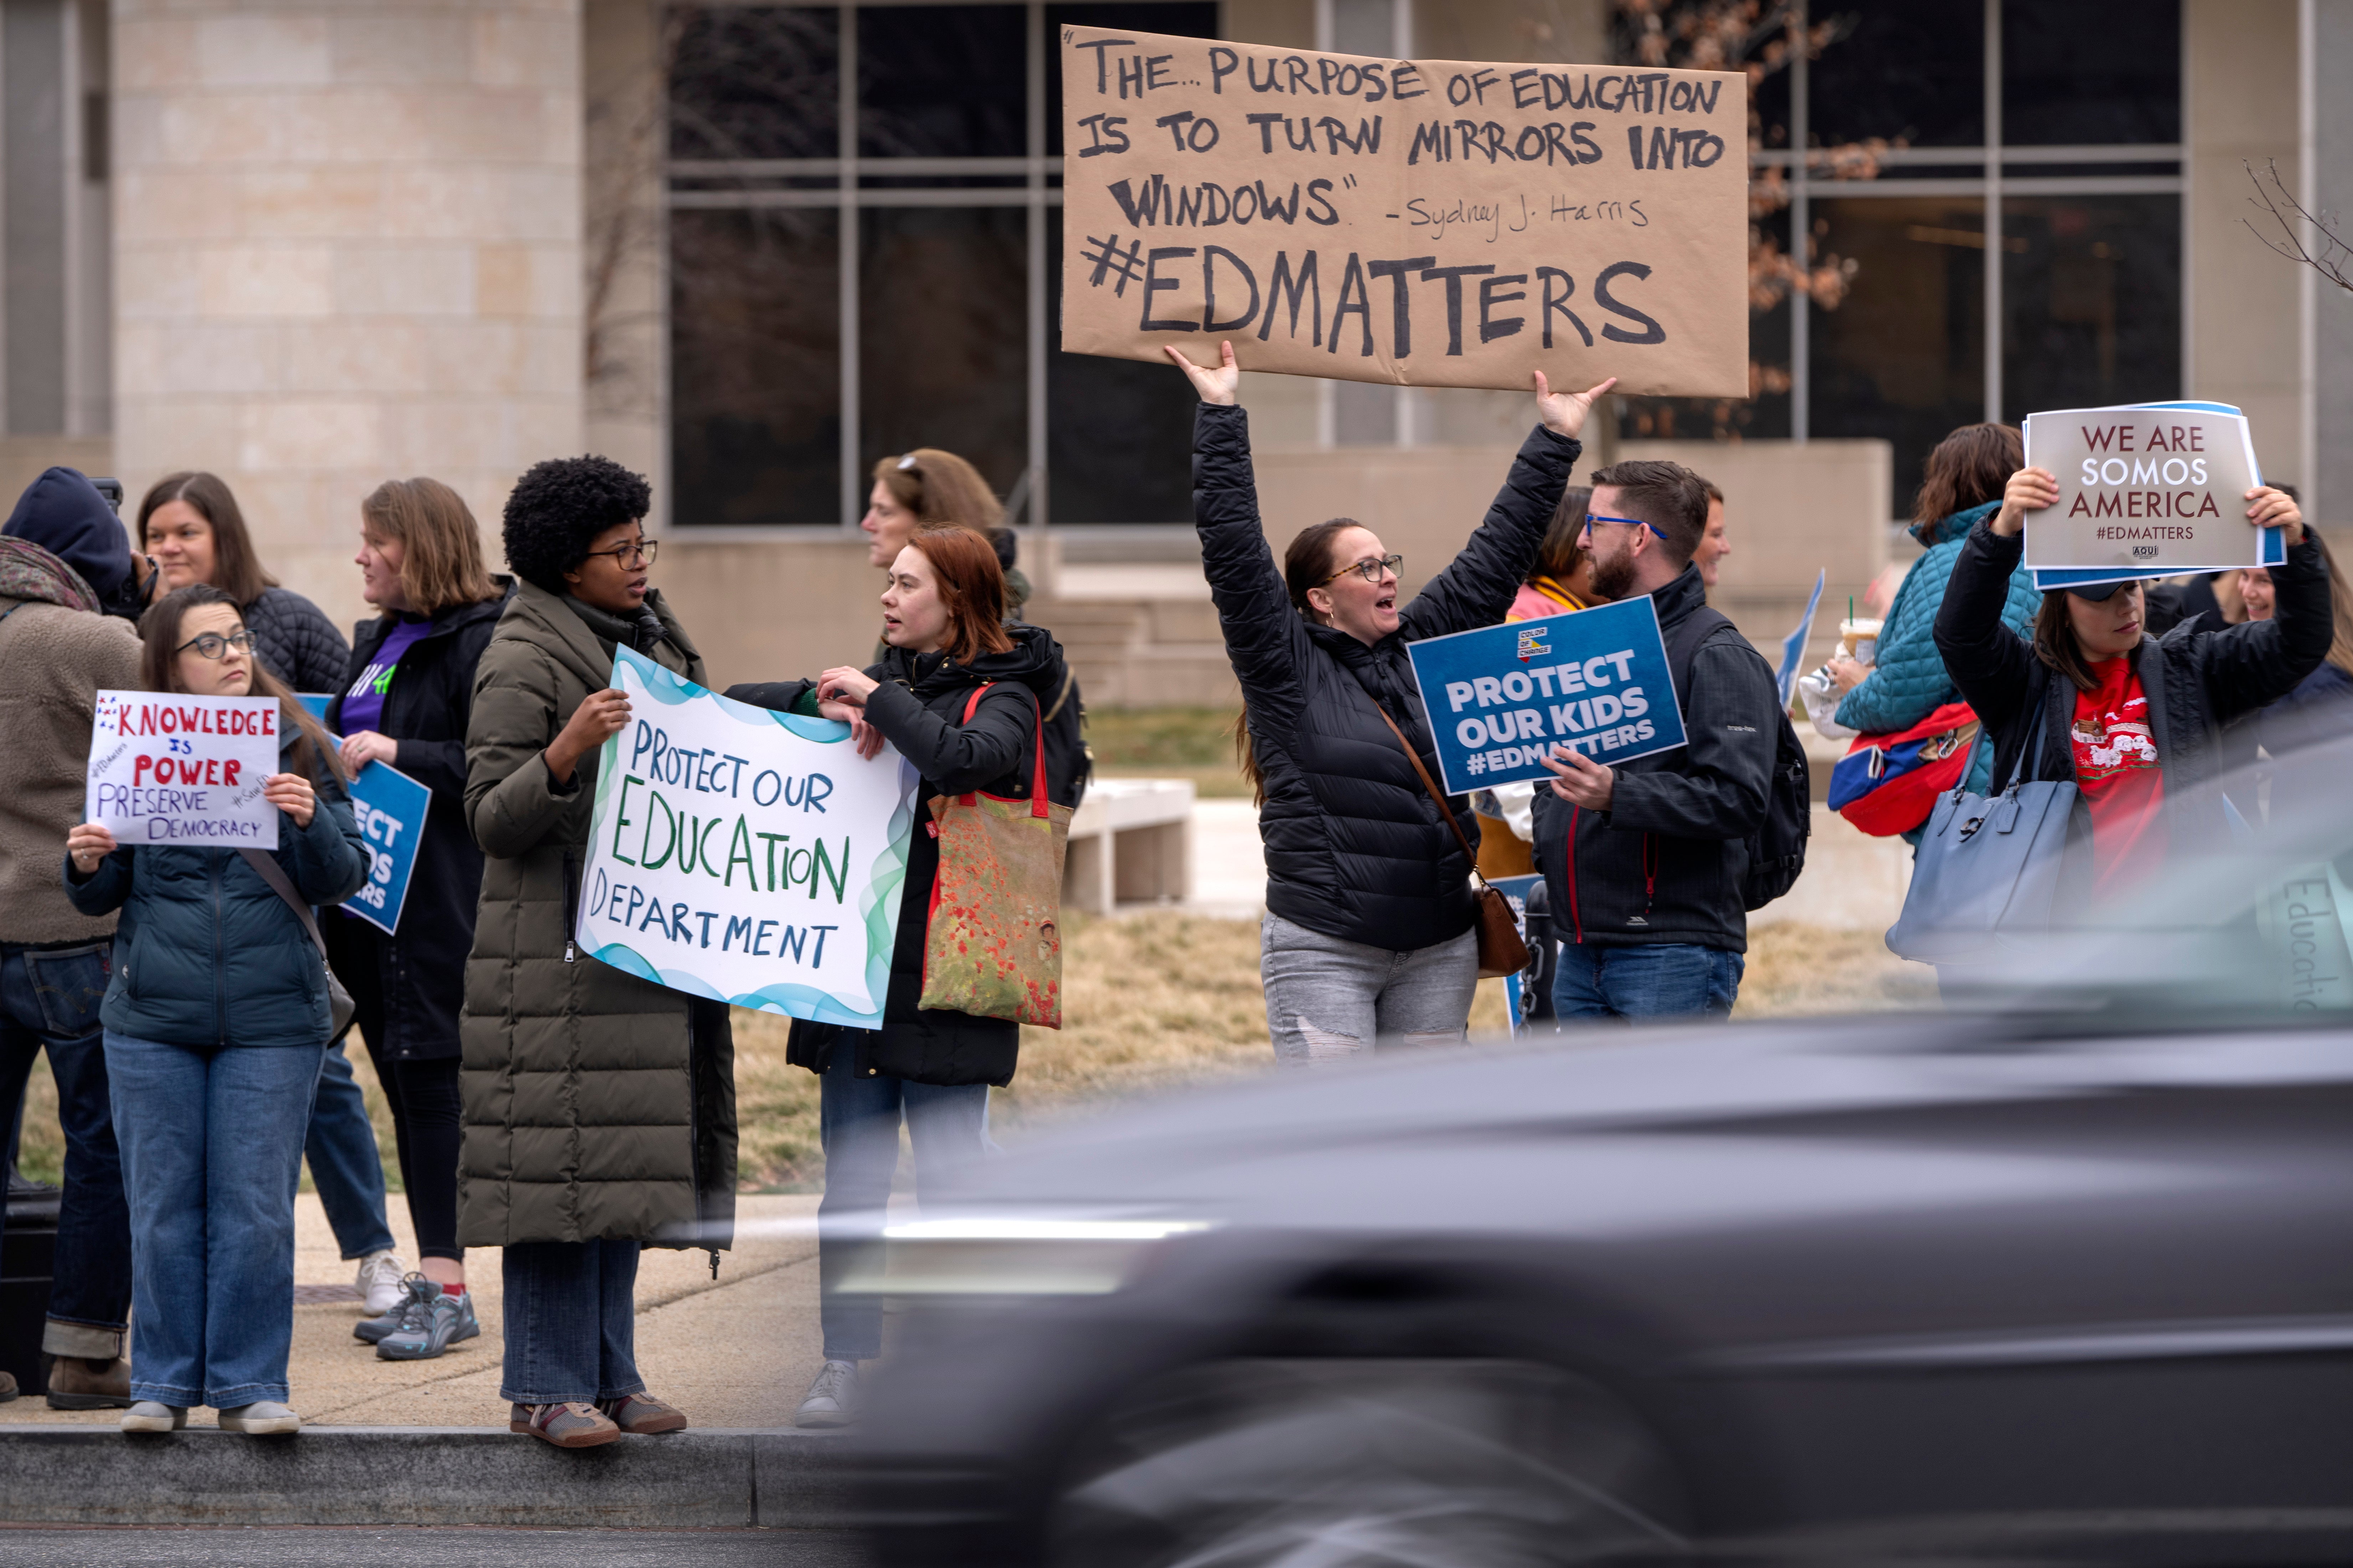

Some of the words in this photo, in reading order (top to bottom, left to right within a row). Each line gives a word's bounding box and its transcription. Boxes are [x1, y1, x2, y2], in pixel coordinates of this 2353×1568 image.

[1208, 47, 1430, 103] PURPOSE
[1446, 68, 1501, 108] OF
[1509, 68, 1723, 115] EDUCATION
[1077, 112, 1131, 158] IS
[1155, 110, 1220, 154] TO
[1245, 113, 1383, 156] TURN
[1407, 119, 1603, 167] MIRRORS
[1627, 125, 1725, 171] INTO
[1509, 194, 1536, 232] J.
[1079, 233, 1667, 359] #EDMATTERS
[2081, 425, 2135, 453] WE
[2146, 425, 2205, 452] ARE
[2081, 457, 2208, 486] SOMOS
[2068, 490, 2220, 519] AMERICA
[2096, 526, 2194, 540] #EDMATTERS
[1521, 629, 1545, 638] COLOR
[1445, 649, 1635, 712] PROTECT
[118, 704, 275, 736] KNOWLEDGE
[1456, 708, 1547, 748] OUR
[1549, 687, 1649, 735] KIDS
[169, 737, 193, 755] IS
[133, 754, 241, 787] POWER
[631, 719, 749, 798] PROTECT
[753, 769, 834, 814] OUR
[97, 782, 208, 818] PRESERVE
[148, 817, 262, 840] DEMOCRACY
[612, 773, 850, 905] EDUCATION
[589, 867, 839, 969] DEPARTMENT
